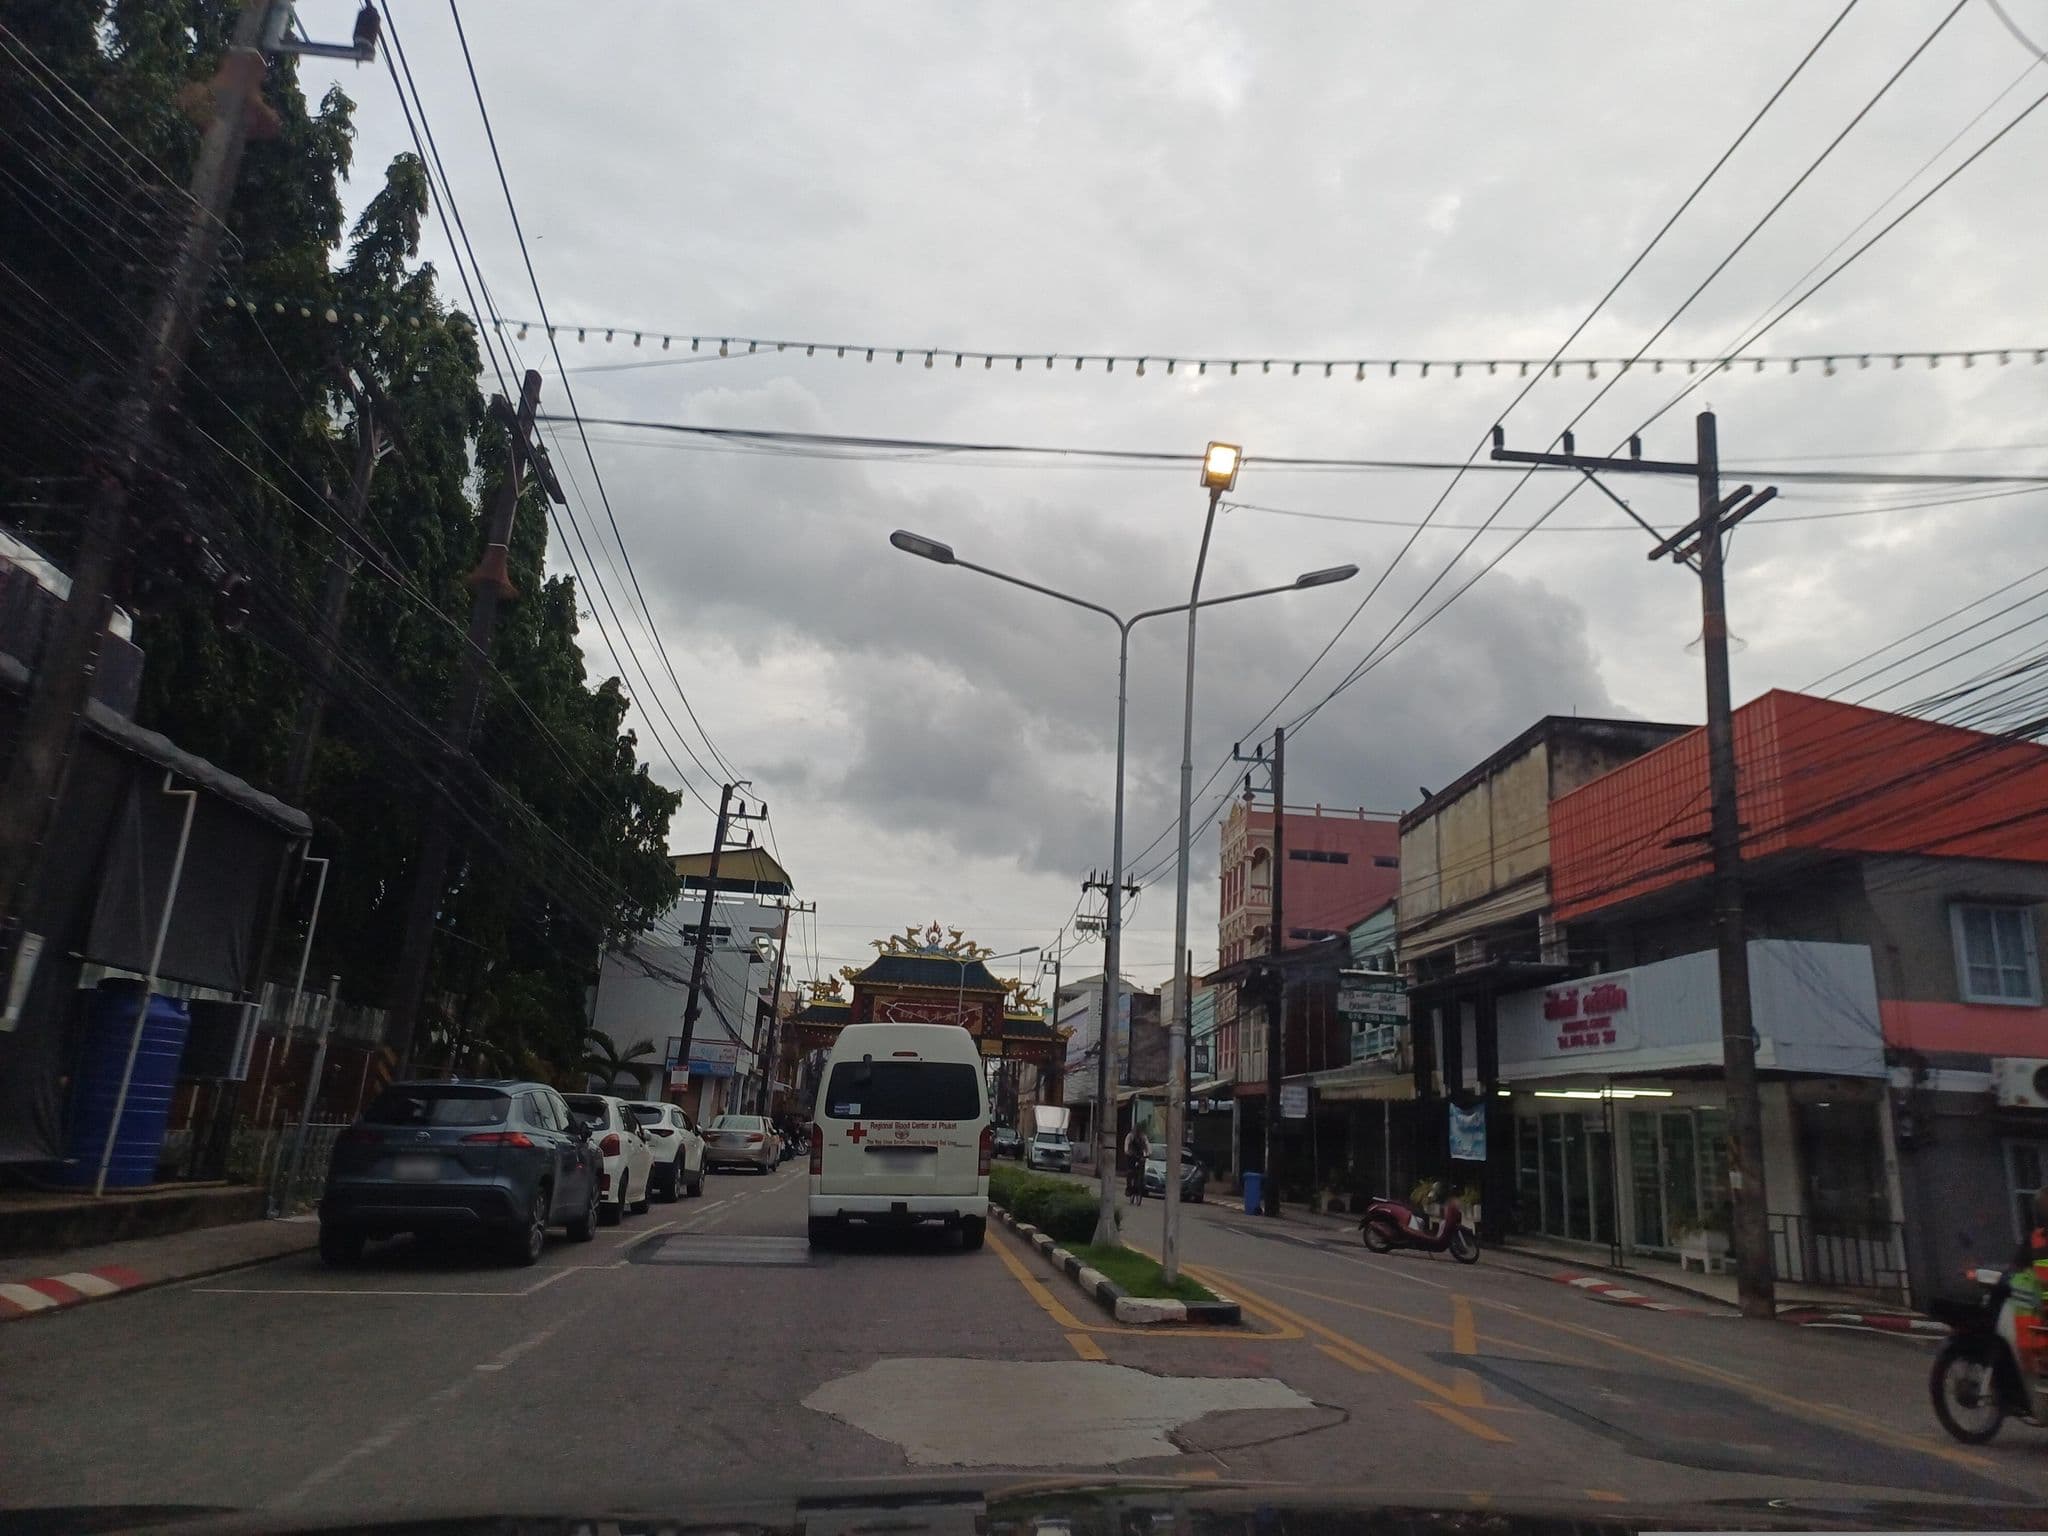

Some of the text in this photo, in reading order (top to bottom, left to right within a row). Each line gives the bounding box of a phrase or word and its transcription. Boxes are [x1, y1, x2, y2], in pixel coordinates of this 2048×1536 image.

[870, 1121, 893, 1131] Regional
[894, 1121, 911, 1129] Blood
[931, 1121, 937, 1129] of
